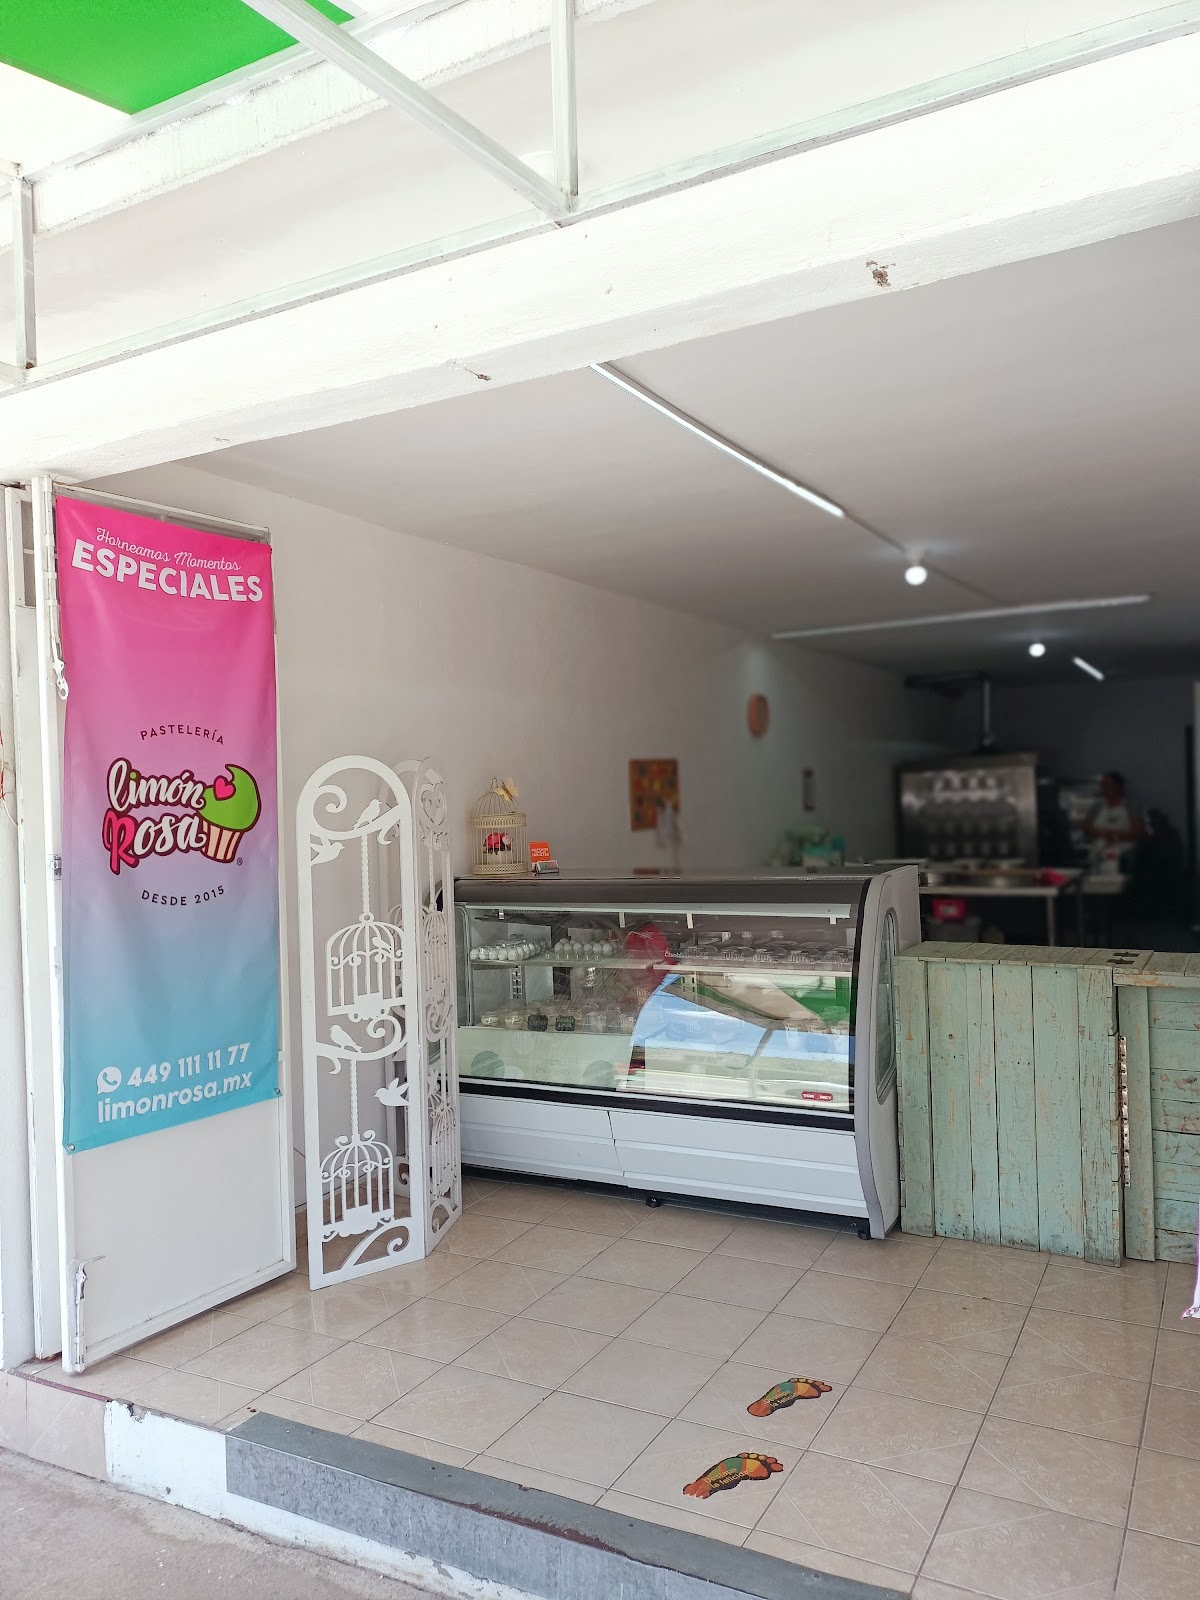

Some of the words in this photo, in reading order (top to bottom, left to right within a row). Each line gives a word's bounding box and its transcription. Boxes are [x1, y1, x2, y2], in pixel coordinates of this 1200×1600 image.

[71, 538, 264, 602] ESPECIALES
[96, 526, 171, 563] Horneamos
[174, 551, 241, 571] Momentos
[140, 724, 225, 746] PASTELERÍA
[107, 757, 206, 812] limón
[102, 808, 207, 875] Rosa
[141, 889, 188, 906] DESDE
[194, 885, 225, 904] 2015
[126, 1061, 172, 1088] 449
[177, 1054, 201, 1078] 111
[207, 1049, 221, 1071] 11
[227, 1042, 251, 1066] 77
[97, 1071, 253, 1124] limonrosa.mx
